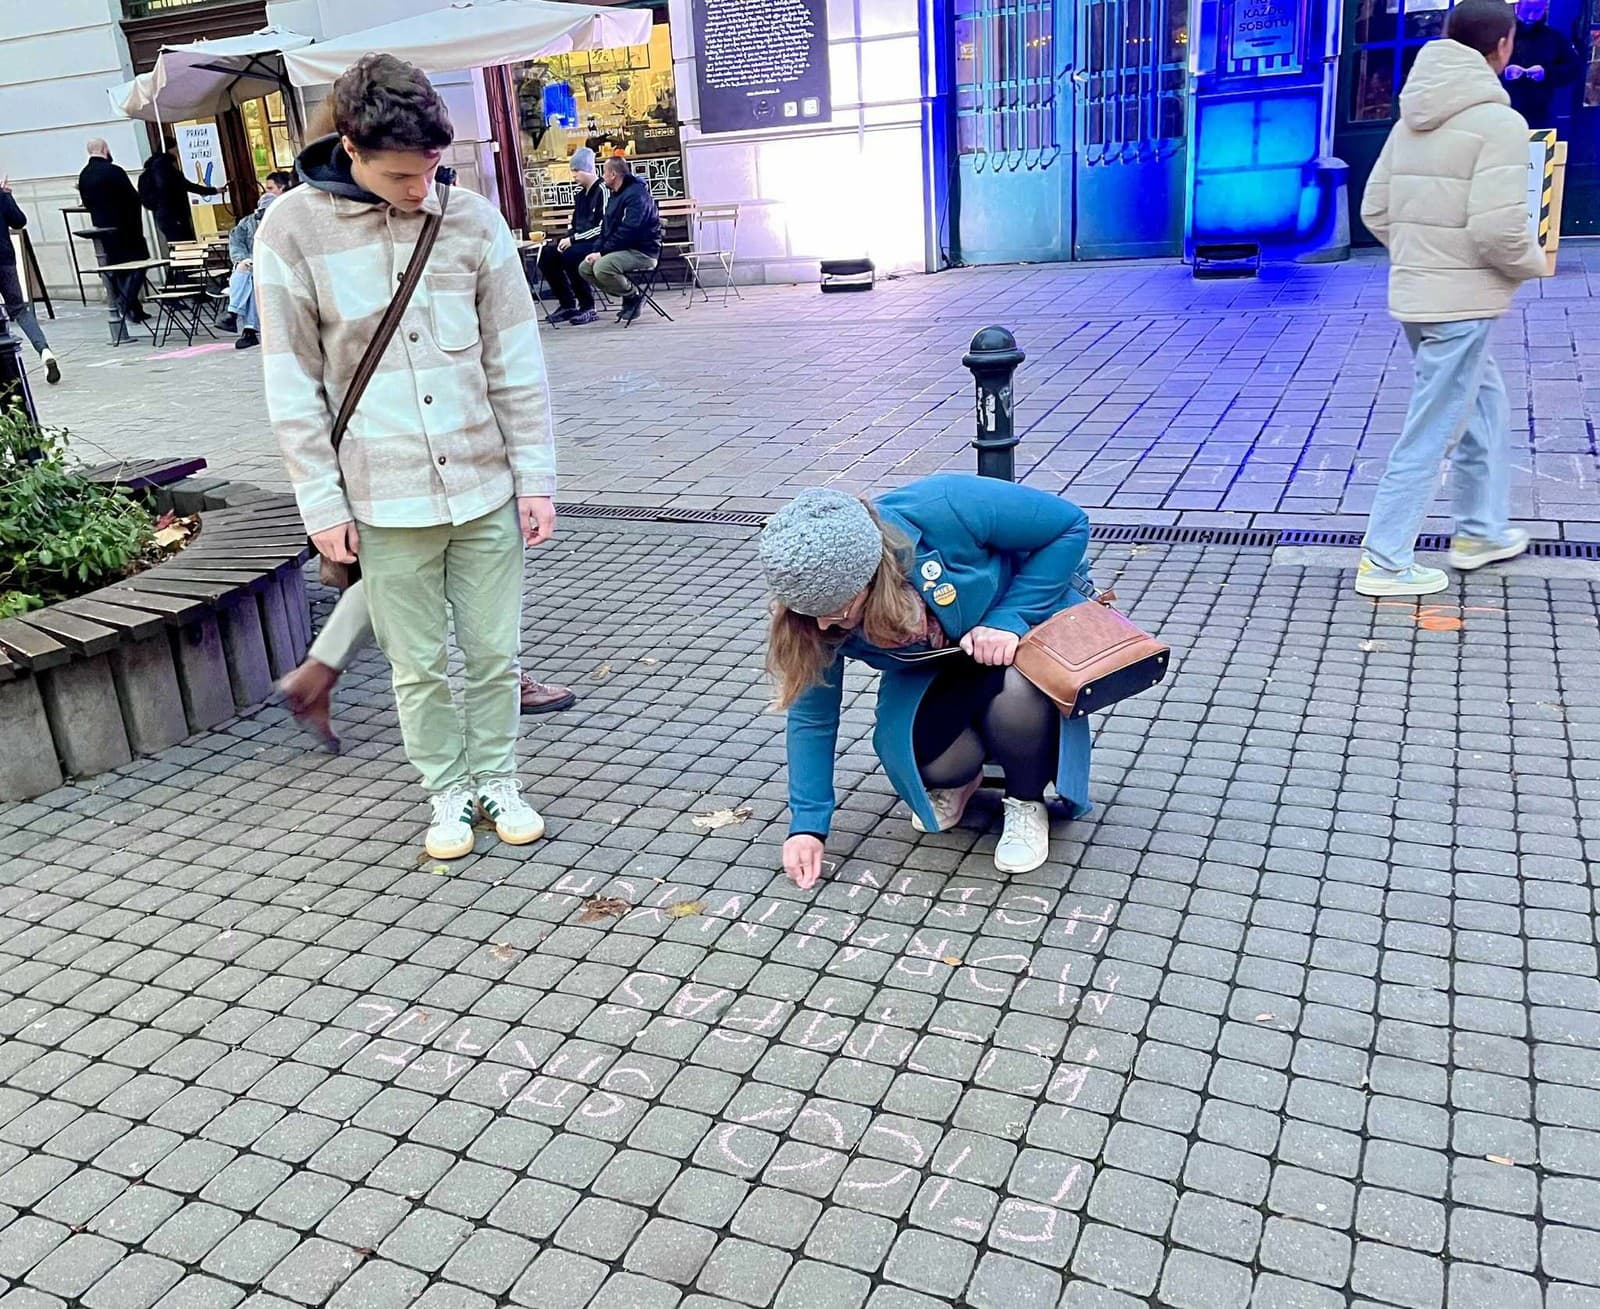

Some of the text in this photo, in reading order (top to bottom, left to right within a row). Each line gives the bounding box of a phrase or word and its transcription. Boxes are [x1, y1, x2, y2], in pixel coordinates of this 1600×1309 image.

[1239, 18, 1289, 32] SOBOTU
[186, 128, 207, 137] PRAVDA
[338, 1003, 1082, 1242] FICO STRATIL
